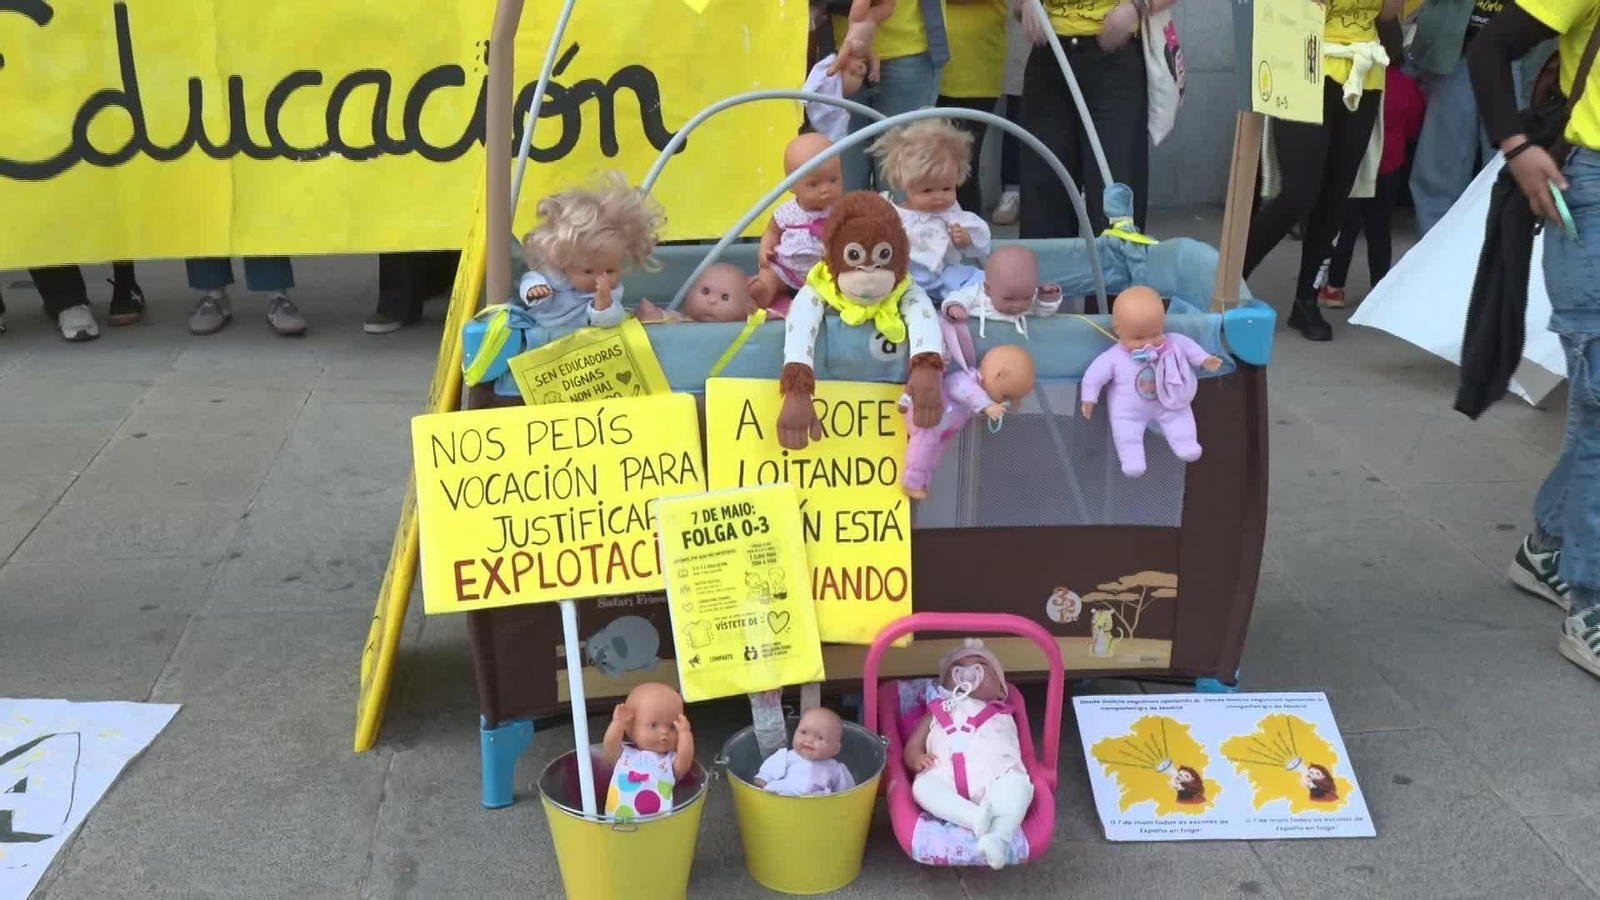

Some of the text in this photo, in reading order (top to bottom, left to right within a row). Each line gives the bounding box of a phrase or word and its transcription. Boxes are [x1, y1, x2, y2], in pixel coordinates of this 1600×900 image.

[534, 344, 623, 388] SEN EDUCADORAS
[562, 368, 606, 392] DIGNAS
[569, 389, 592, 403] NON
[594, 380, 614, 395] HAI
[431, 407, 633, 468] NOS PEDÍS
[736, 398, 896, 440] A ROFE
[620, 451, 699, 492] PARA
[681, 522, 738, 550] FOLGA
[741, 516, 770, 537] 0-3
[691, 502, 757, 525] 7 DE MAIO:
[836, 500, 904, 543] ESTÁ
[454, 532, 663, 602] EXPLOTACI
